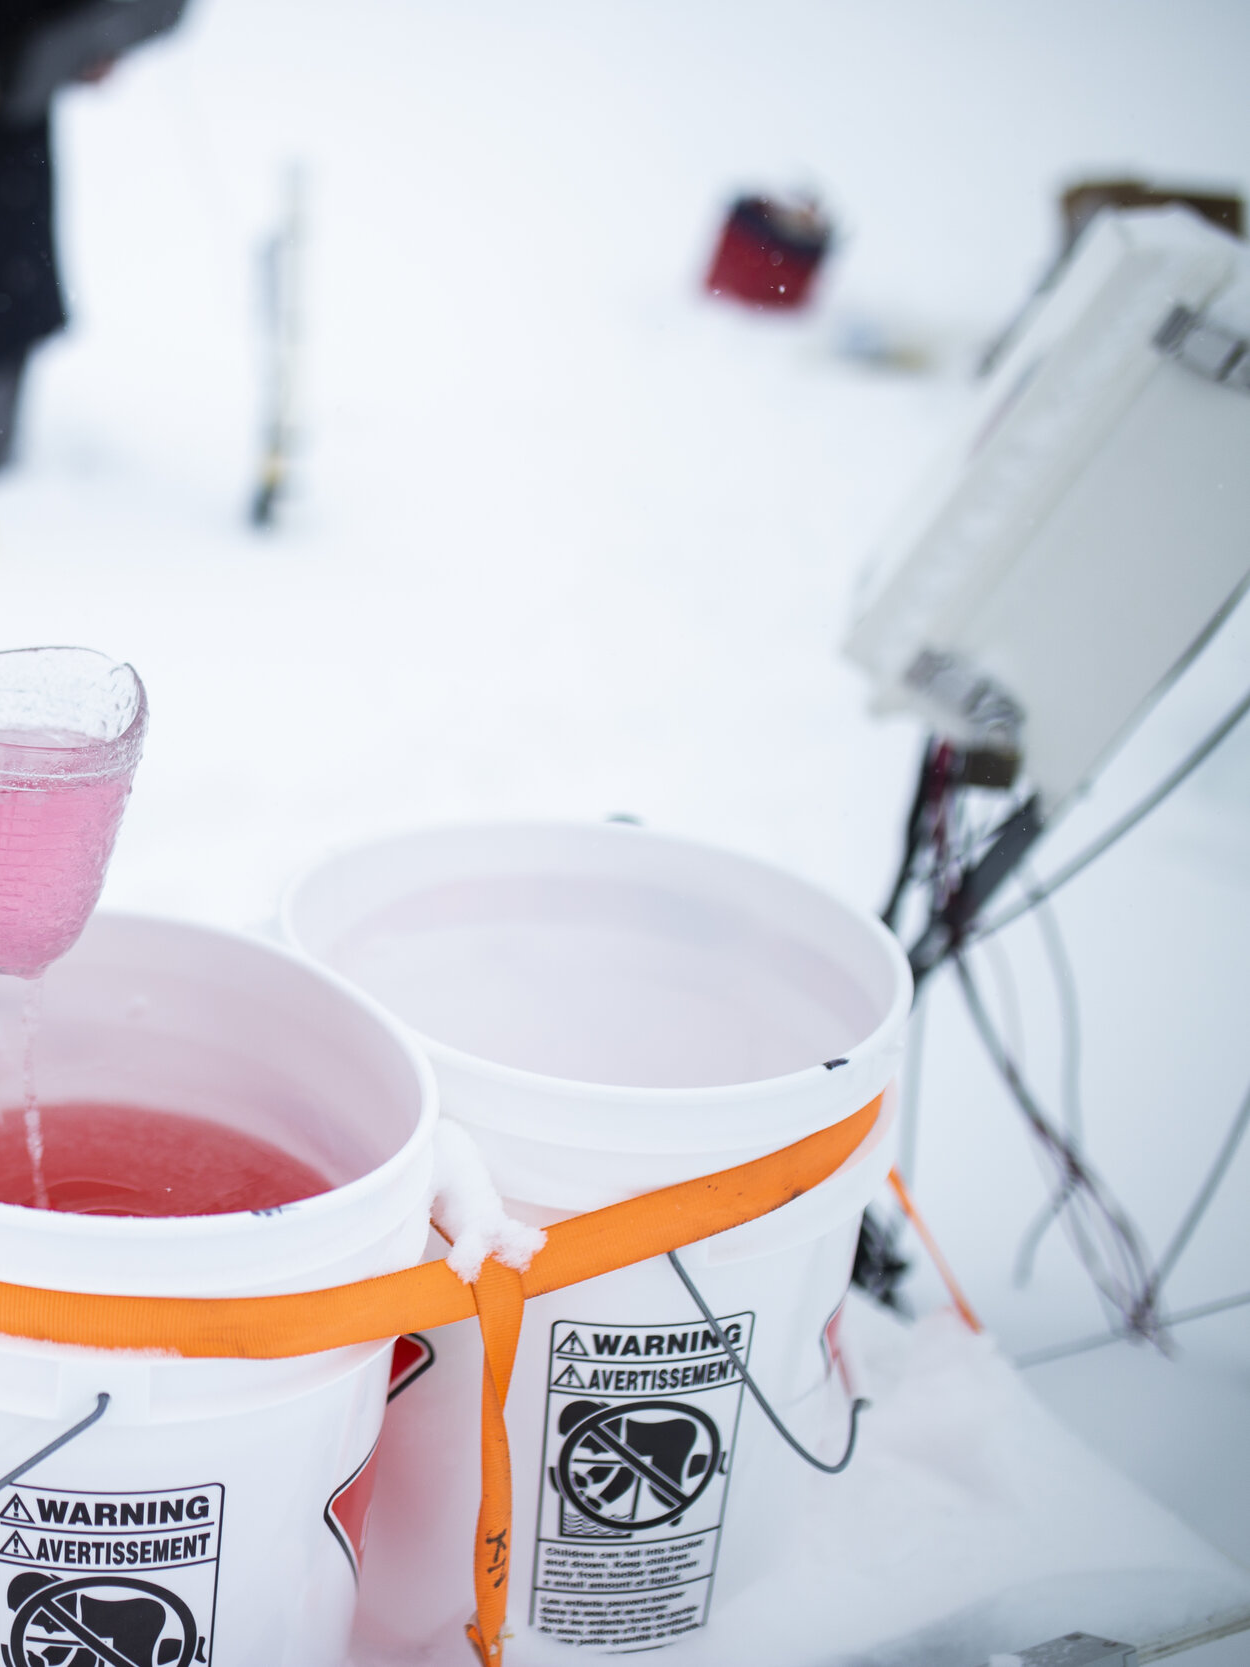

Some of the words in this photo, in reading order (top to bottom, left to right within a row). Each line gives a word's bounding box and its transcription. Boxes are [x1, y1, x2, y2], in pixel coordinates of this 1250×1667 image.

[592, 1323, 742, 1357] WARNING
[588, 1358, 741, 1391] AVERTISSEMENT
[36, 1495, 210, 1527] WARNING
[36, 1532, 211, 1565] AVERTISSEMENT
[544, 1558, 567, 1568] and
[613, 1560, 641, 1570] Keep
[645, 1553, 689, 1567] children
[546, 1547, 595, 1559] Children
[600, 1551, 619, 1559] can
[624, 1549, 640, 1558] fall
[644, 1547, 665, 1557] into
[669, 1538, 705, 1552] bucket
[544, 1568, 573, 1579] away
[577, 1570, 603, 1579] from
[607, 1569, 645, 1579] bucket
[649, 1565, 670, 1576] with
[674, 1560, 699, 1571] even
[553, 1579, 584, 1588] small
[588, 1580, 632, 1590] amount
[634, 1578, 646, 1588] of
